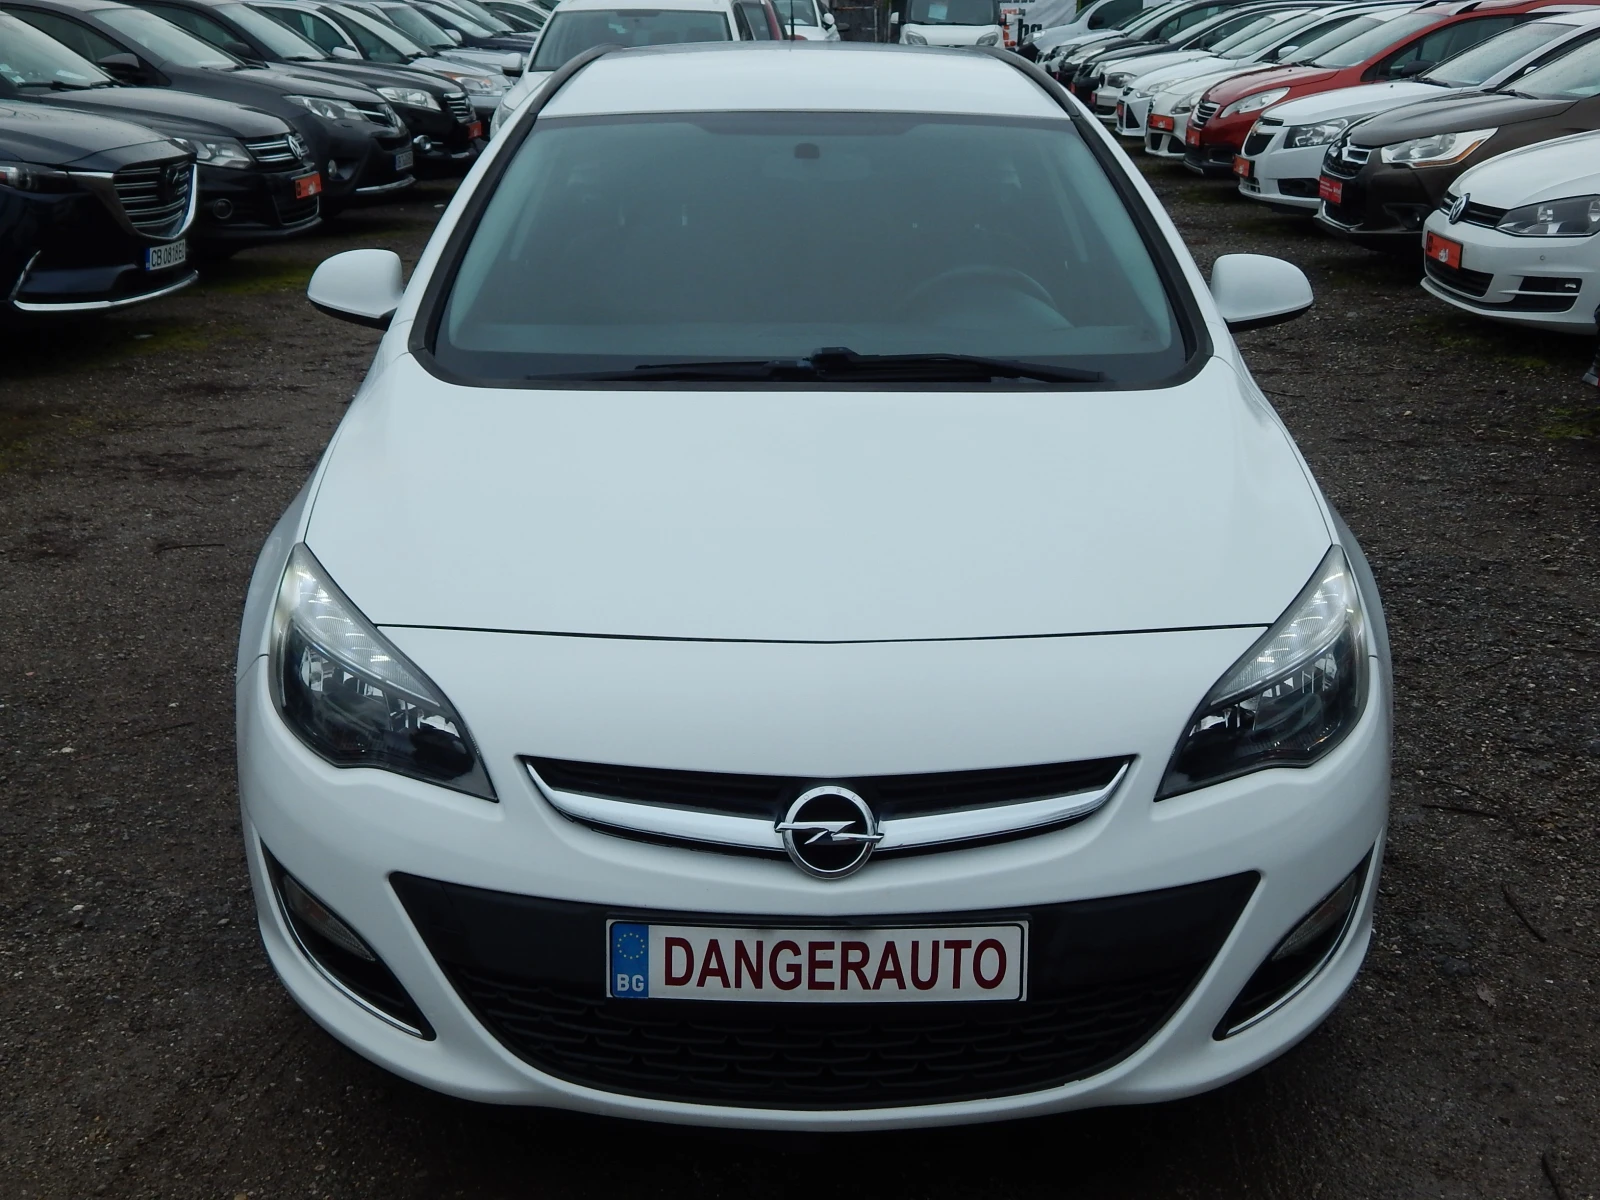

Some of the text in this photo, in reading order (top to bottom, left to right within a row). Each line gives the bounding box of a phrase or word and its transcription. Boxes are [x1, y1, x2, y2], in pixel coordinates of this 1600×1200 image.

[803, 787, 857, 801] OPEL
[617, 936, 1007, 992] BG DANGERAUTO
